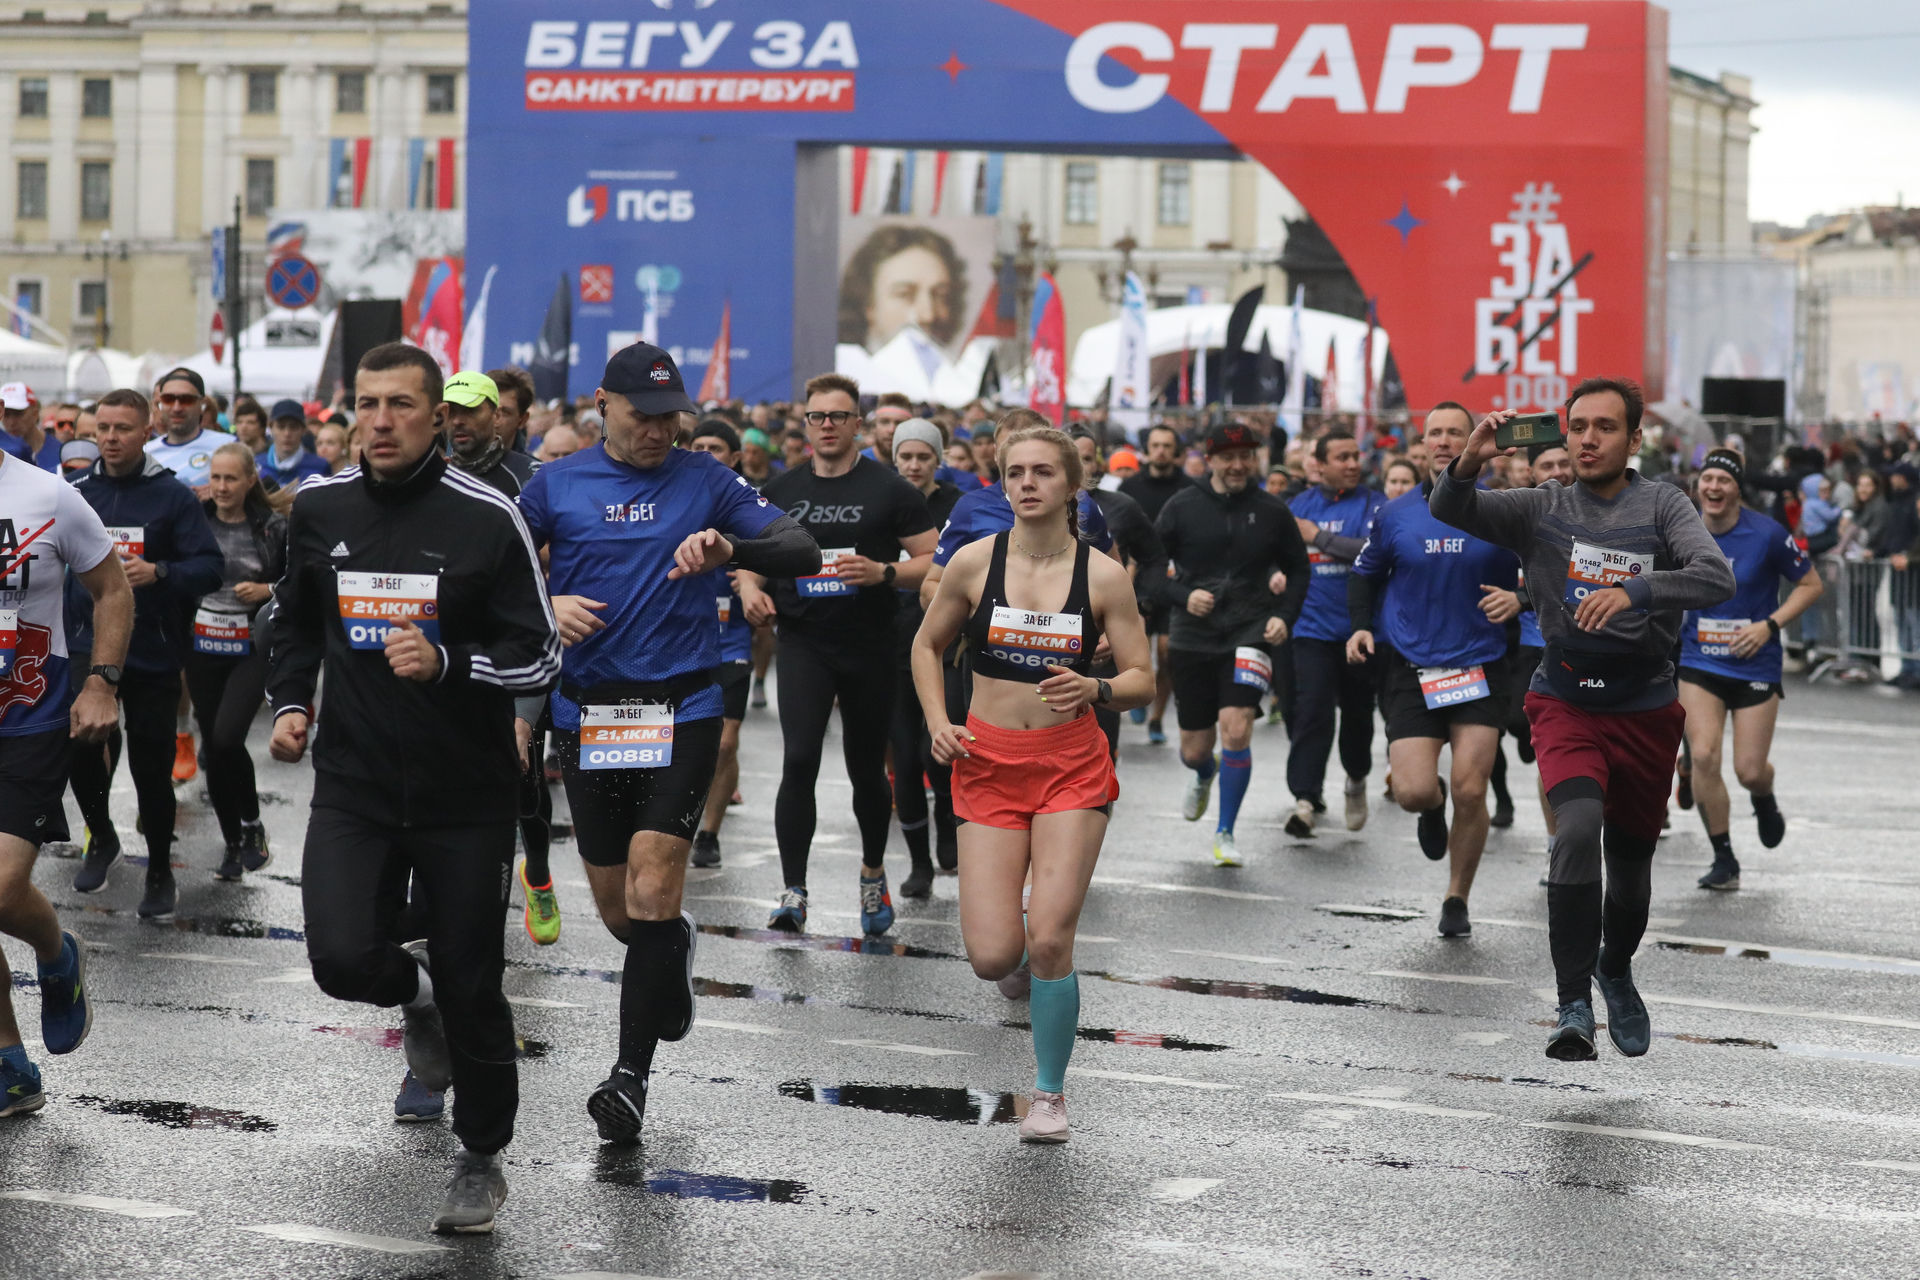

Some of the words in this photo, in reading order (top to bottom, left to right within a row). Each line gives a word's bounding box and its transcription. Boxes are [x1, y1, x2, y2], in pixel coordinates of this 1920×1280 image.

[524, 20, 735, 68] БЕГУ
[749, 20, 859, 68] ЗА
[1065, 21, 1589, 113] СТАРТ
[527, 78, 851, 102] САНКТ-ПЕТЕРБУРГ
[616, 189, 695, 222] ПСБ
[1490, 222, 1578, 299] ЗА
[1475, 298, 1594, 375] БЕГ
[808, 505, 863, 523] asics
[1579, 678, 1605, 688] FILA
[627, 708, 643, 719] БЕГ
[589, 749, 663, 764] 00881
